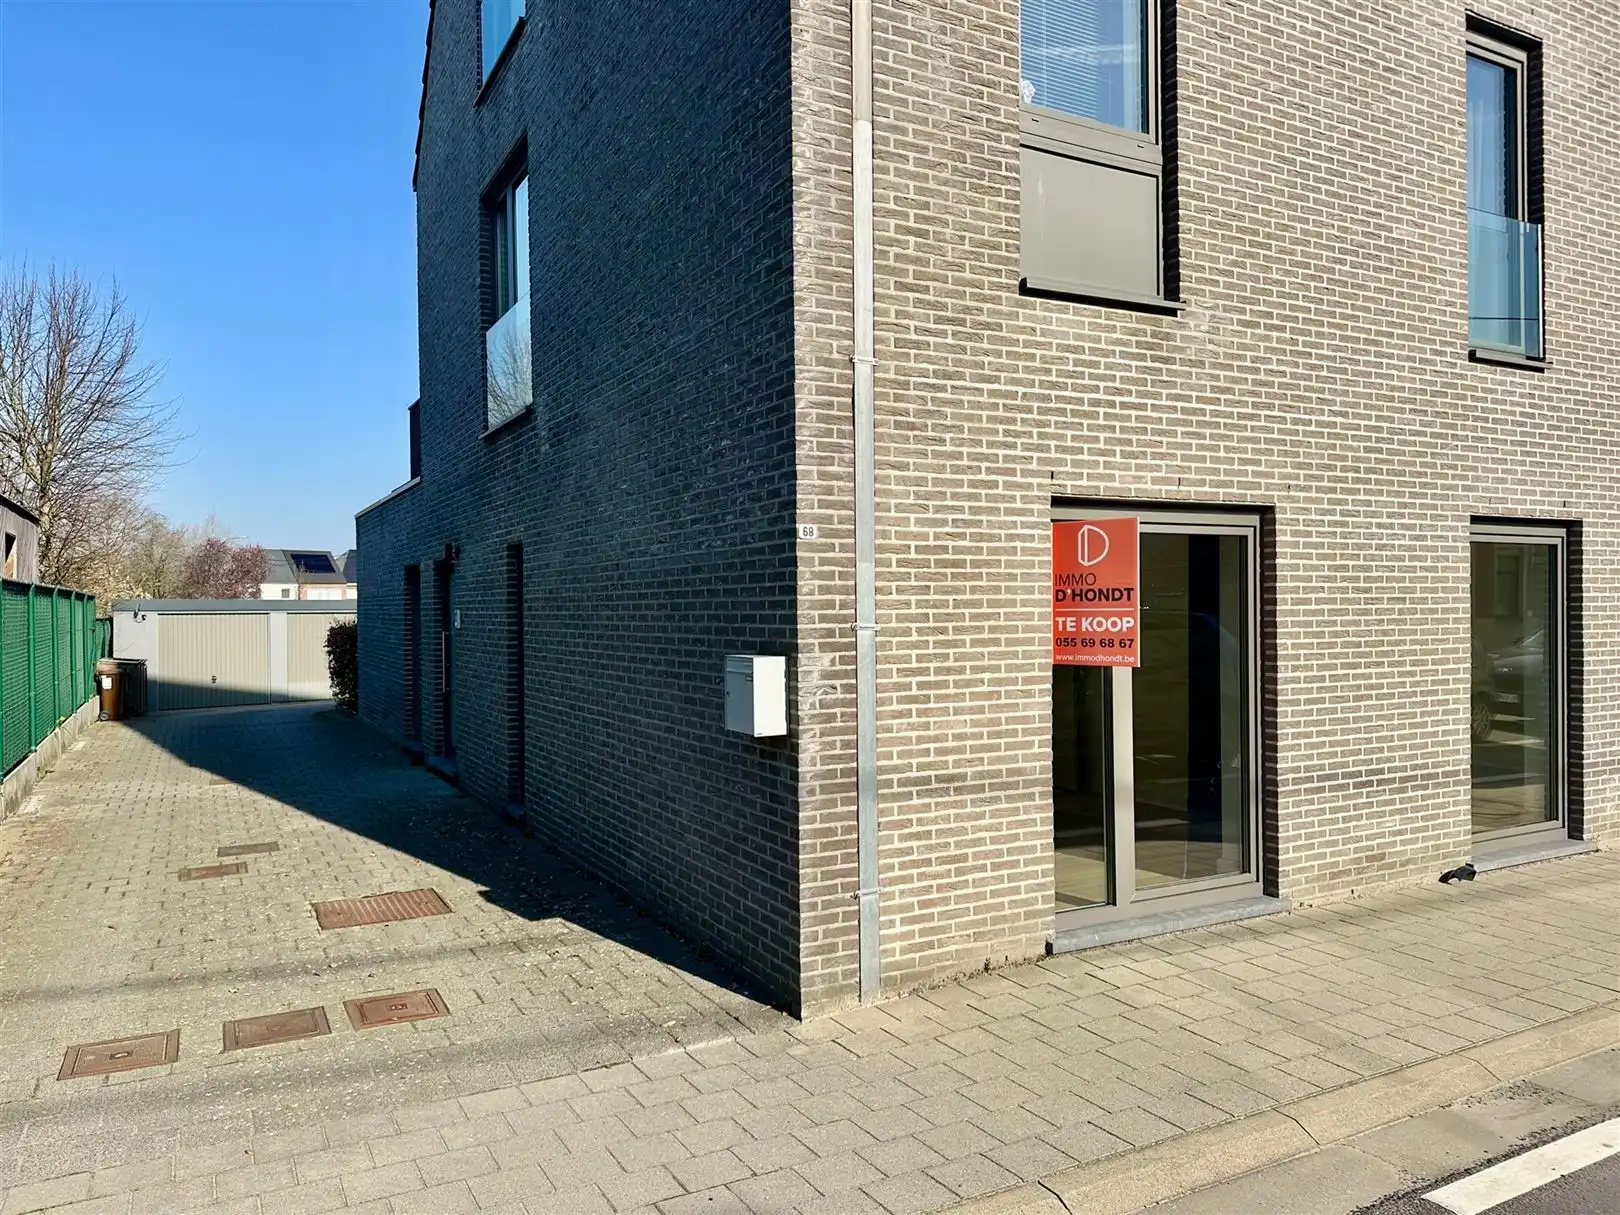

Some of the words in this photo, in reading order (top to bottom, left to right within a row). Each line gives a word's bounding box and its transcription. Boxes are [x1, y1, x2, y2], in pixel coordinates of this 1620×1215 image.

[803, 526, 814, 537] 68
[1055, 572, 1097, 587] IMMO
[1055, 587, 1134, 603] D'HONDT
[1055, 617, 1077, 632] TE
[1081, 616, 1135, 633] KOOP
[1055, 637, 1077, 648] 055
[1080, 637, 1096, 648] 69
[1099, 638, 1115, 649] 68
[1119, 638, 1135, 649] 67
[1055, 653, 1135, 663] www.immodhondt.be
